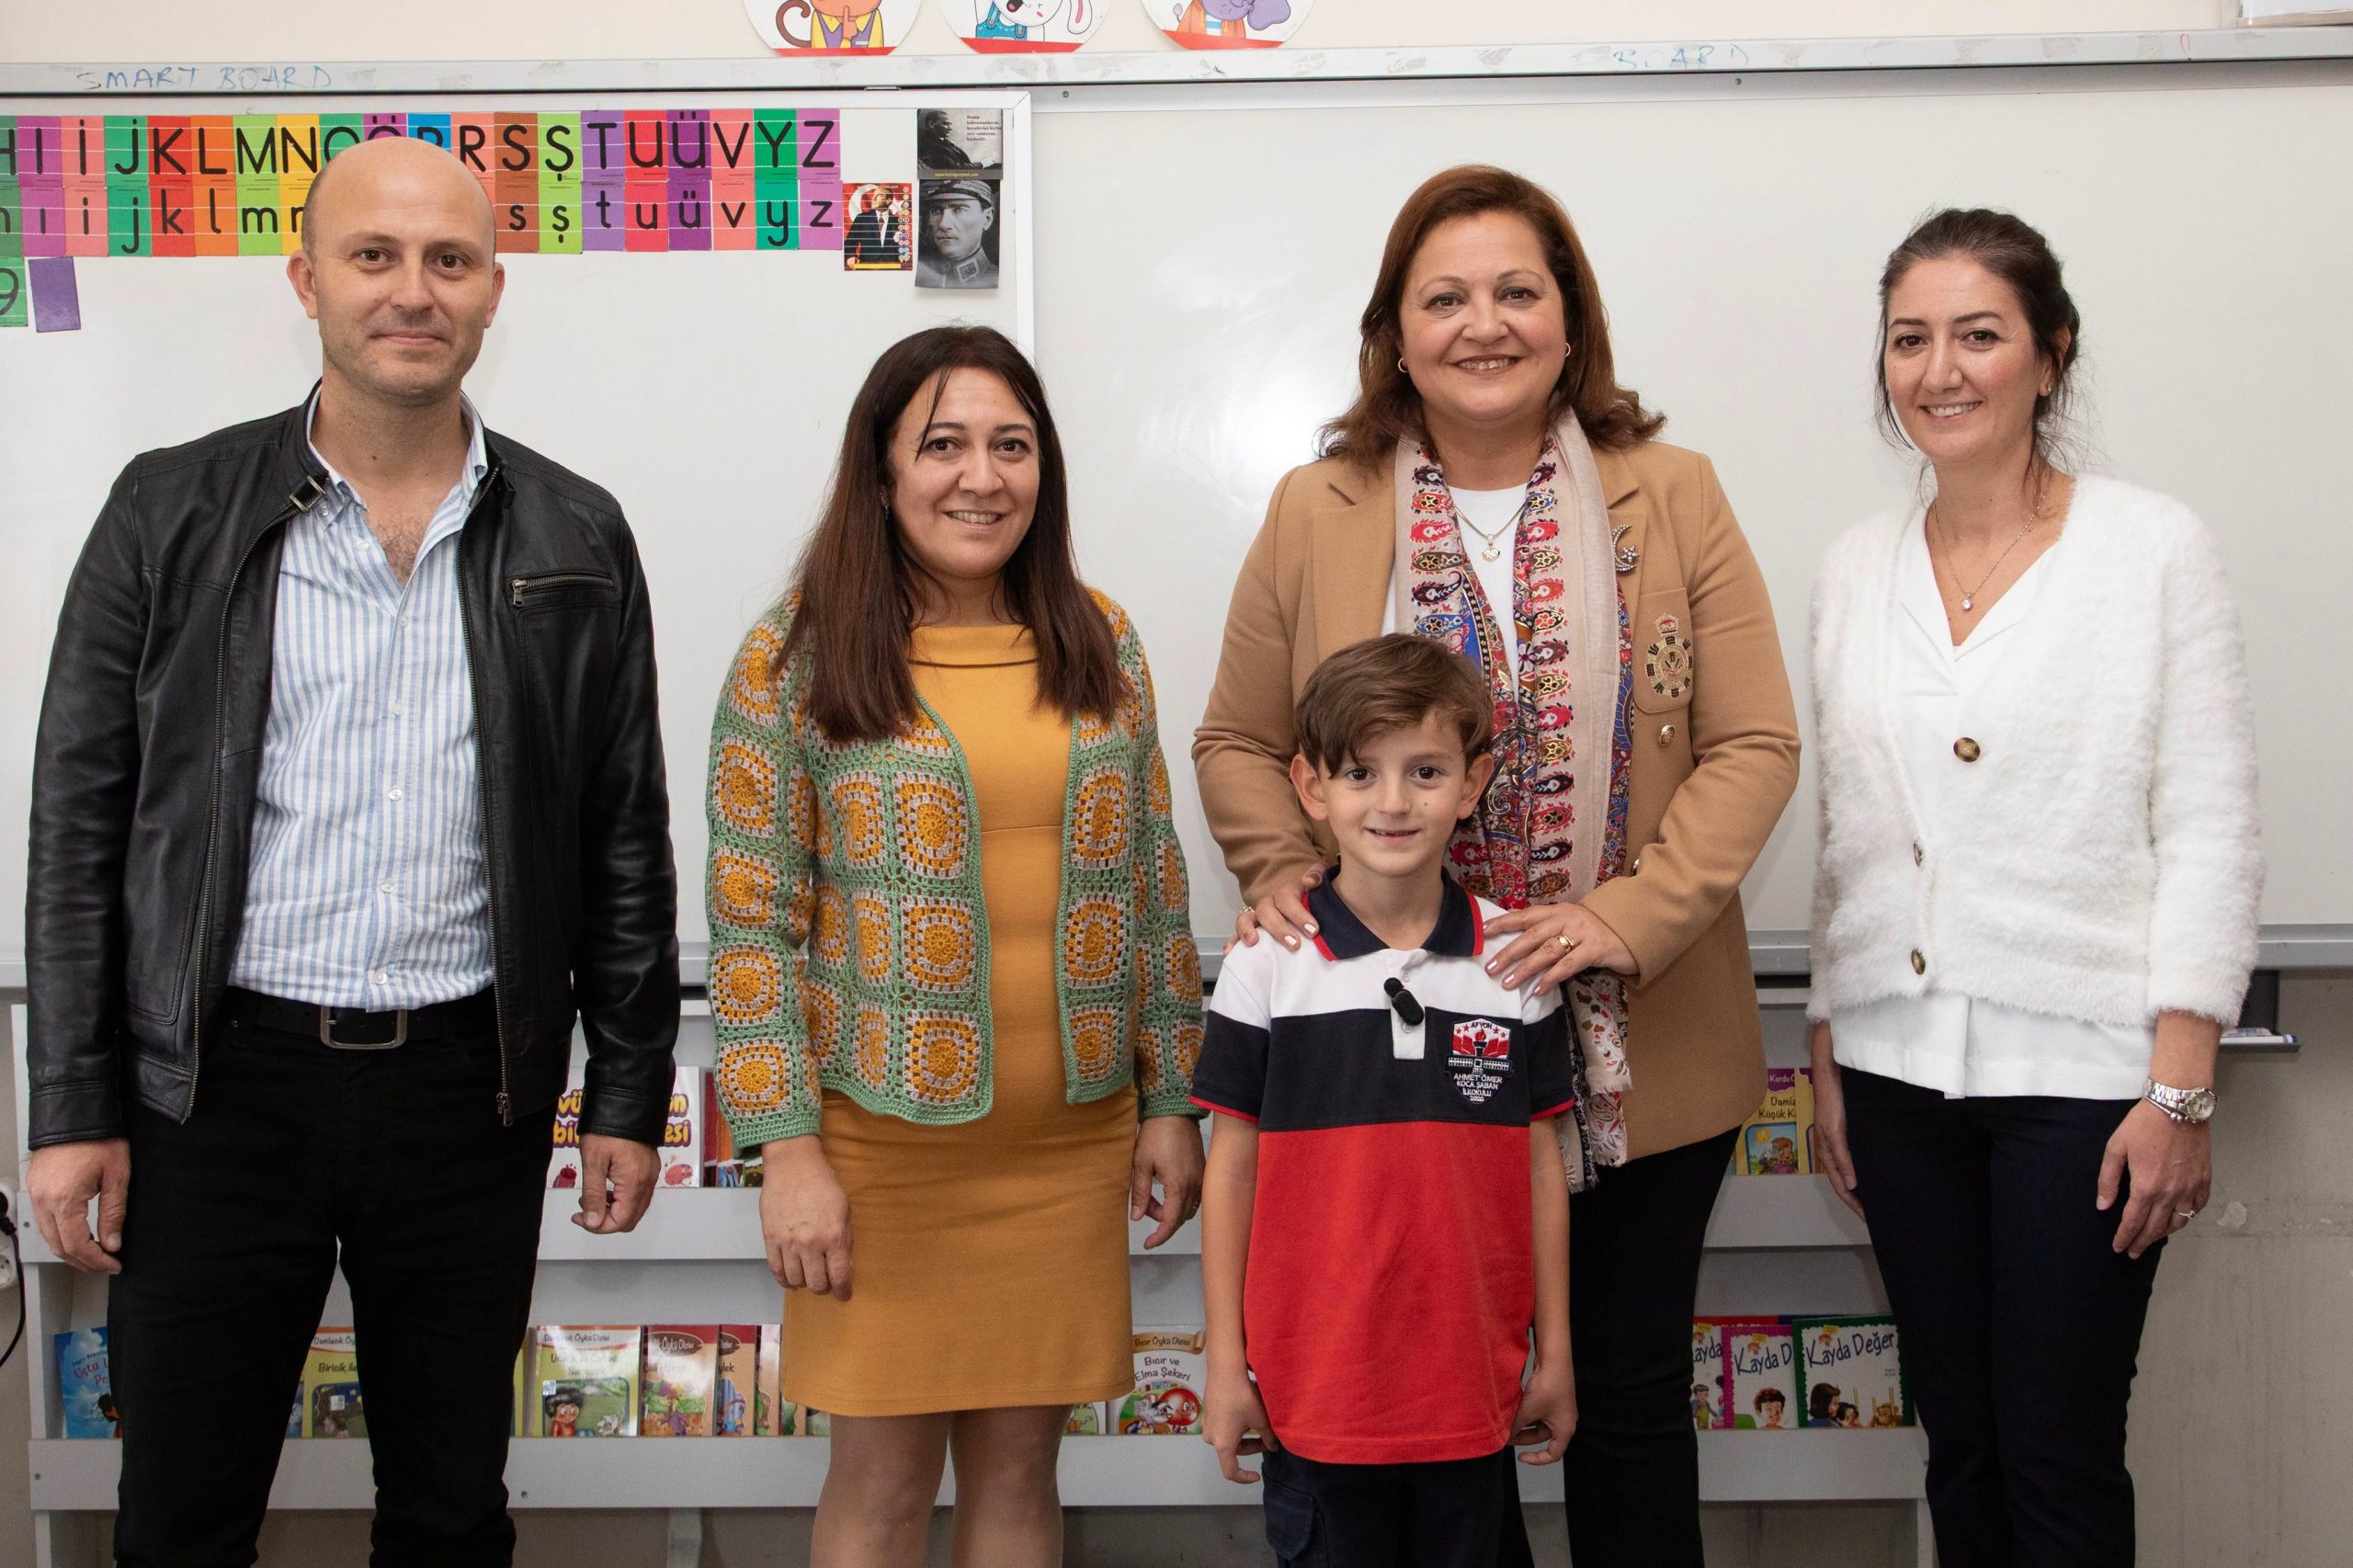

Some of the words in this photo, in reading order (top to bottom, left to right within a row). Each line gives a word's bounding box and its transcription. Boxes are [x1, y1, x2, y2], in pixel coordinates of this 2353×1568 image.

[76, 66, 199, 90] SMART
[220, 66, 331, 90] BOARD
[1476, 1082, 1498, 1090] ŞABAN
[1481, 1074, 1503, 1083] ÖMER
[1693, 1337, 1722, 1364] ayda
[1734, 1347, 1779, 1375] Kayda
[1806, 1337, 1851, 1368] Kayda
[1852, 1332, 1894, 1357] Değer
[1134, 1369, 1158, 1381] Elma
